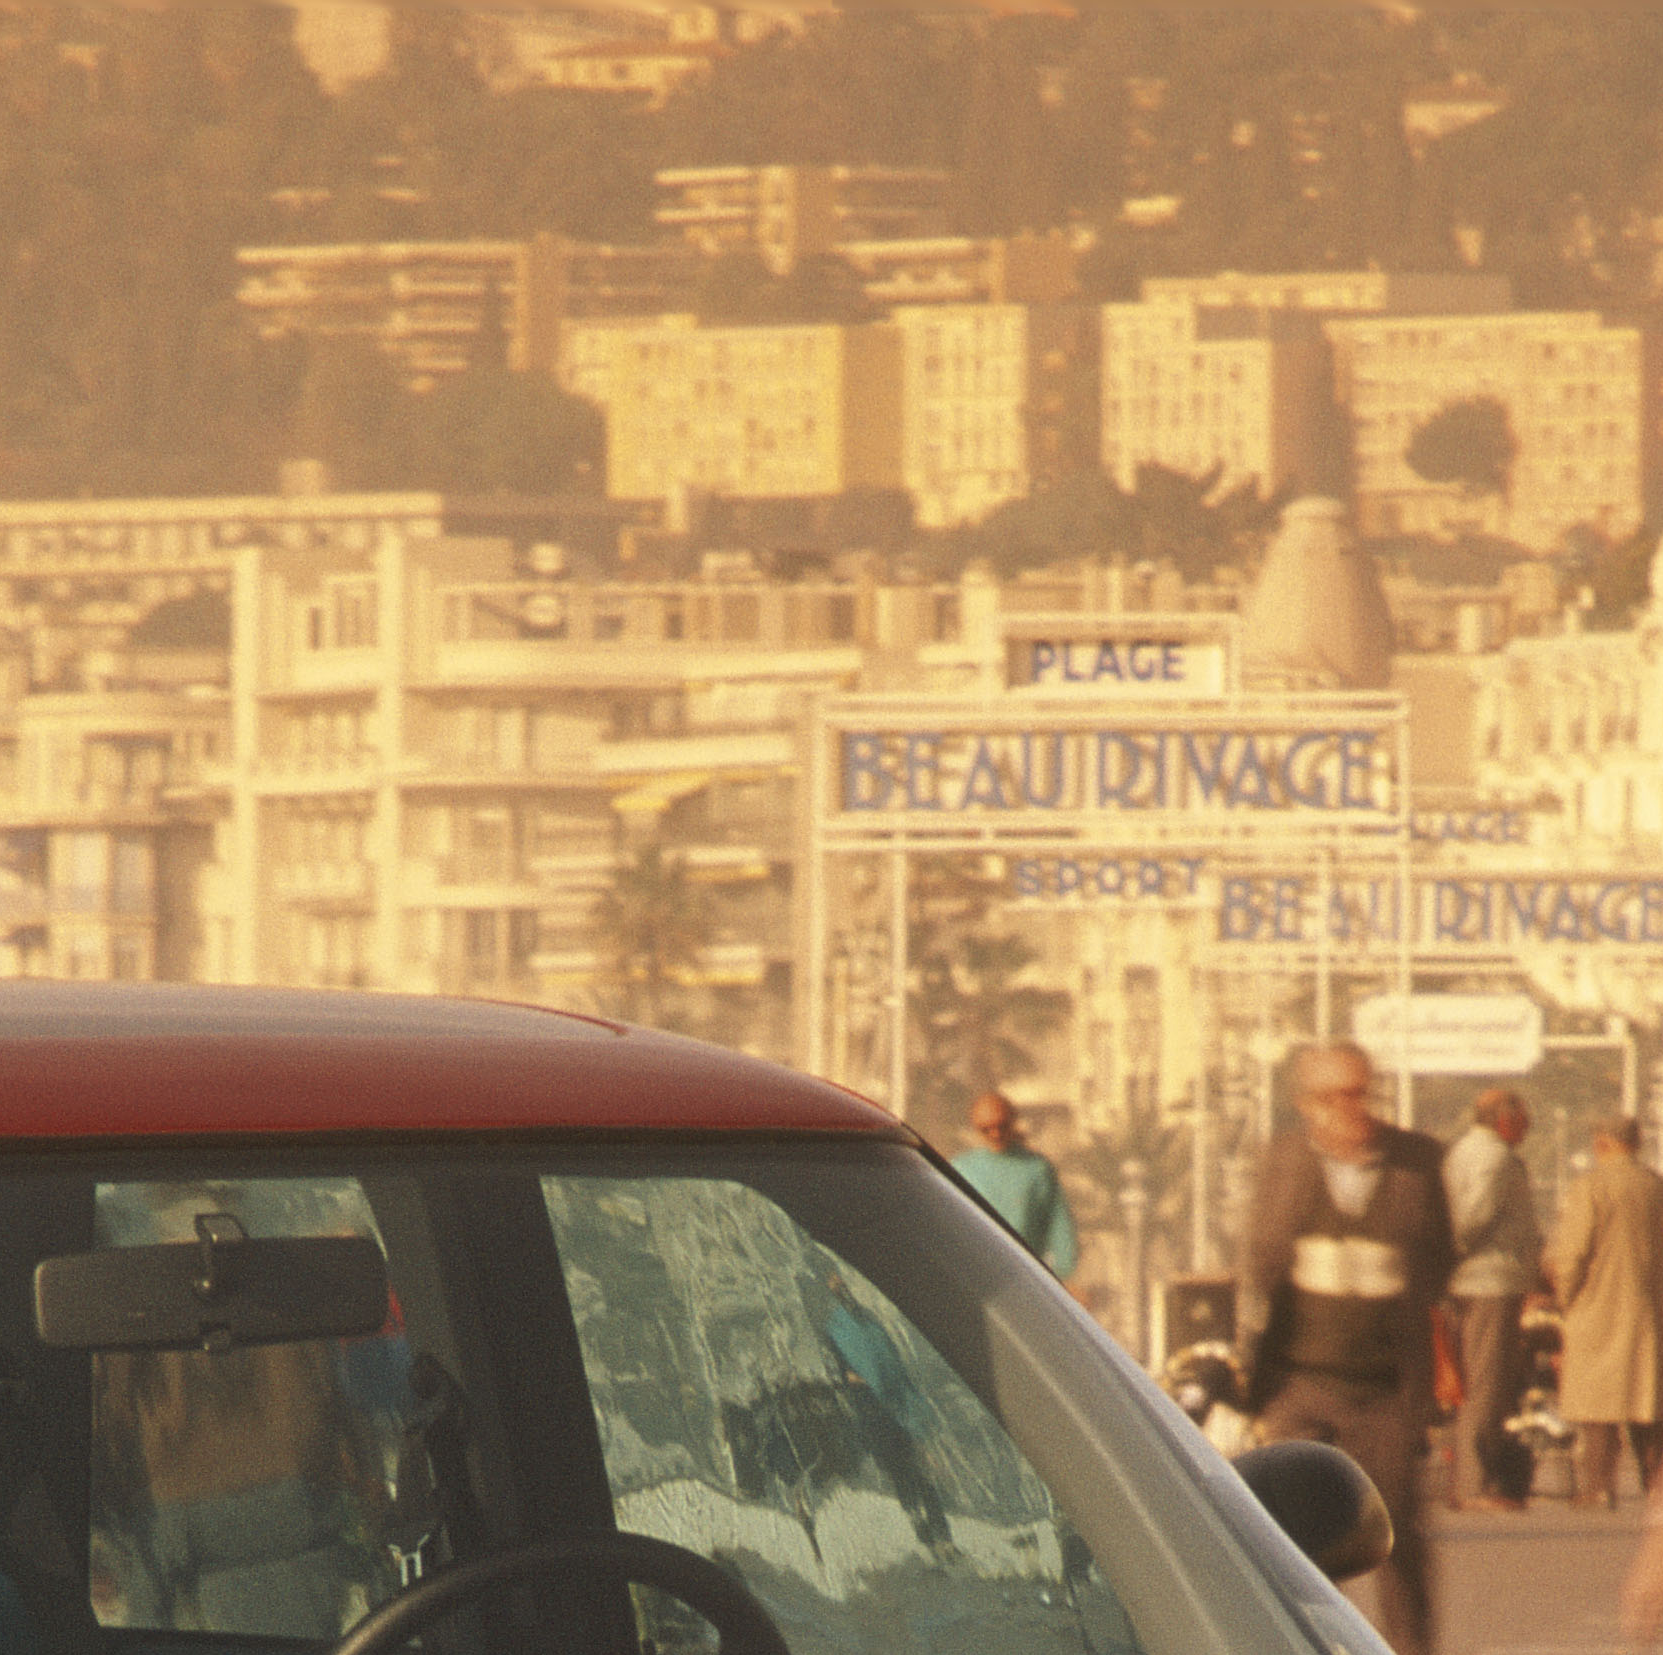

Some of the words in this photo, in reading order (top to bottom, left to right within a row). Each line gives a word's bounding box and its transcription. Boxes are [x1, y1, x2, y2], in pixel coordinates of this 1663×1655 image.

[1030, 639, 1186, 682] PLAGE
[842, 731, 1066, 811] BEAU
[1095, 731, 1378, 811] RIVAGE
[1378, 810, 1526, 843] LAGE
[1014, 857, 1207, 897] SPORT
[1221, 876, 1404, 943] BEAU
